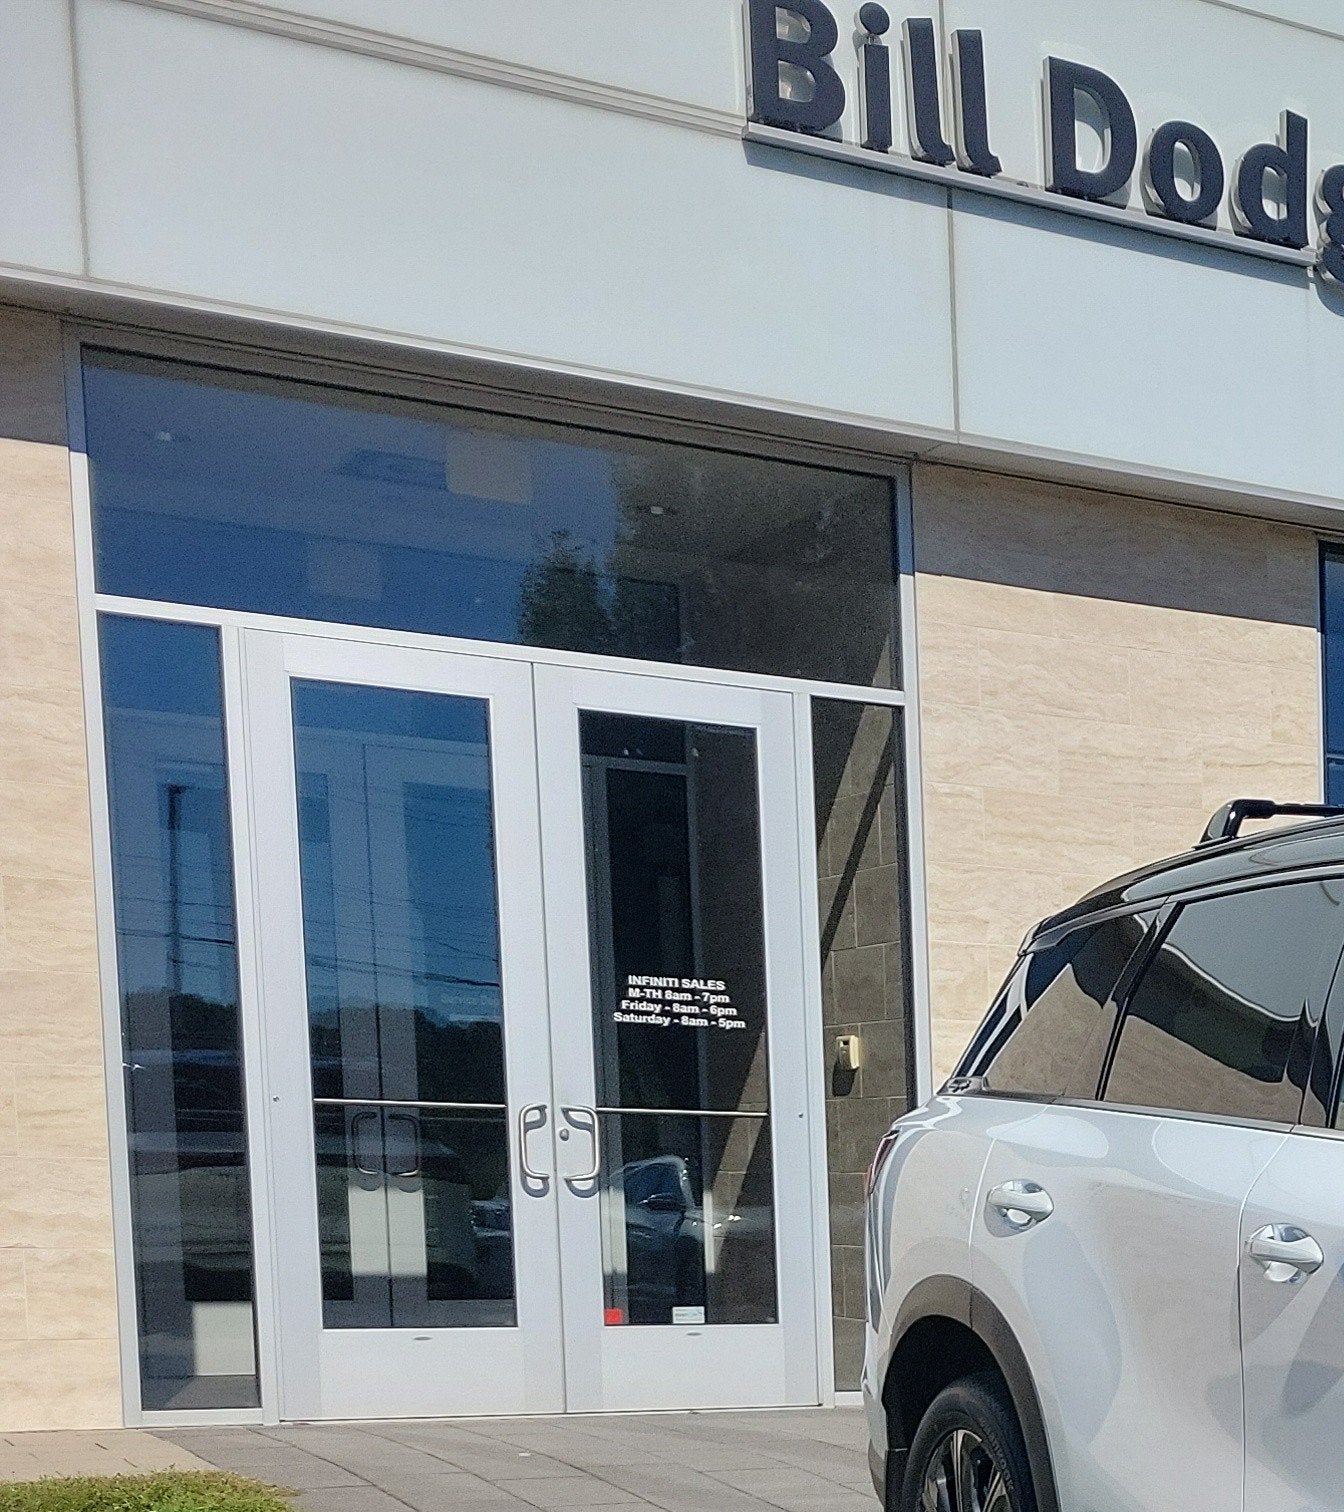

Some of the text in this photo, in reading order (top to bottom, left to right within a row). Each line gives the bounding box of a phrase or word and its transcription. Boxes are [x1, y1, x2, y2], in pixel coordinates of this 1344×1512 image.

[744, 0, 1002, 178] Bill
[628, 975, 726, 990] INFINITI SALES
[628, 987, 663, 999] M-TH
[702, 992, 730, 1004] 7pm
[621, 1000, 662, 1013] Friday
[672, 1003, 700, 1014] 8am
[710, 1005, 737, 1017] 6pm
[614, 1012, 671, 1026] Saturday
[681, 1015, 708, 1026] 8am
[718, 1018, 746, 1030] 5pm
